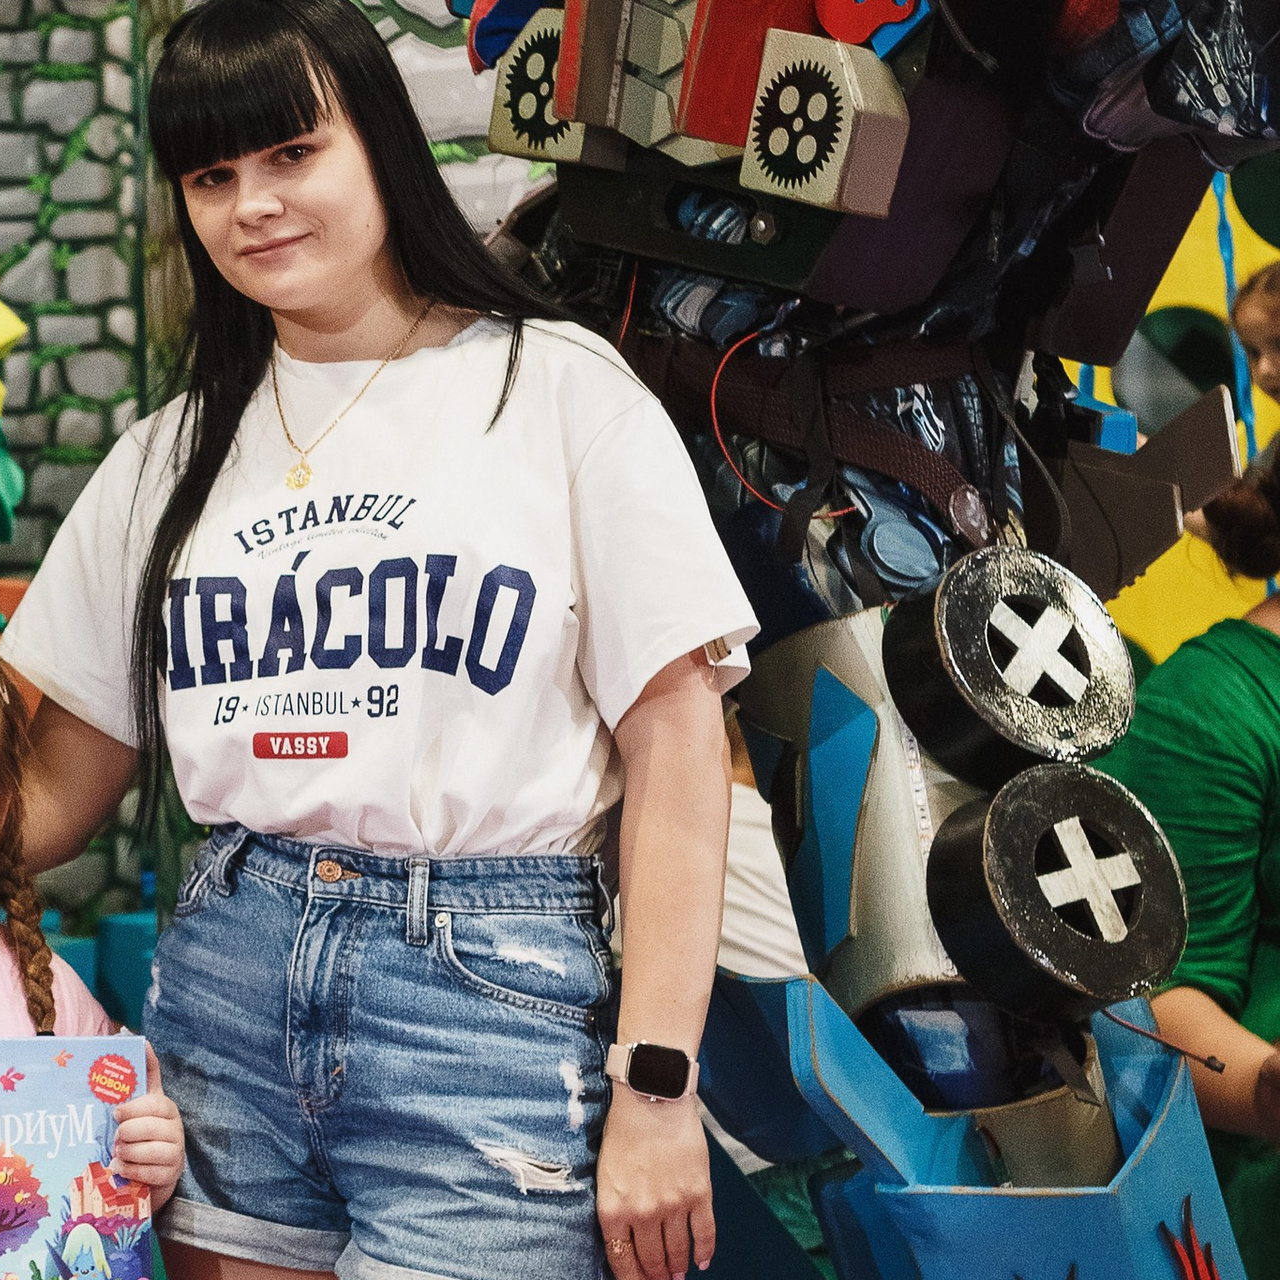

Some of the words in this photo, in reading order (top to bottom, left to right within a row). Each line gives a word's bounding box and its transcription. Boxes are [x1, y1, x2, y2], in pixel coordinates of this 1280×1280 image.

[234, 494, 417, 554] ISTANBUL
[167, 550, 537, 697] IRÁCOLO
[214, 696, 240, 726] 19
[255, 691, 349, 717] ISTANBUL
[366, 684, 400, 719] 92
[269, 735, 330, 756] VASSY
[92, 1072, 130, 1094] НОВОМ
